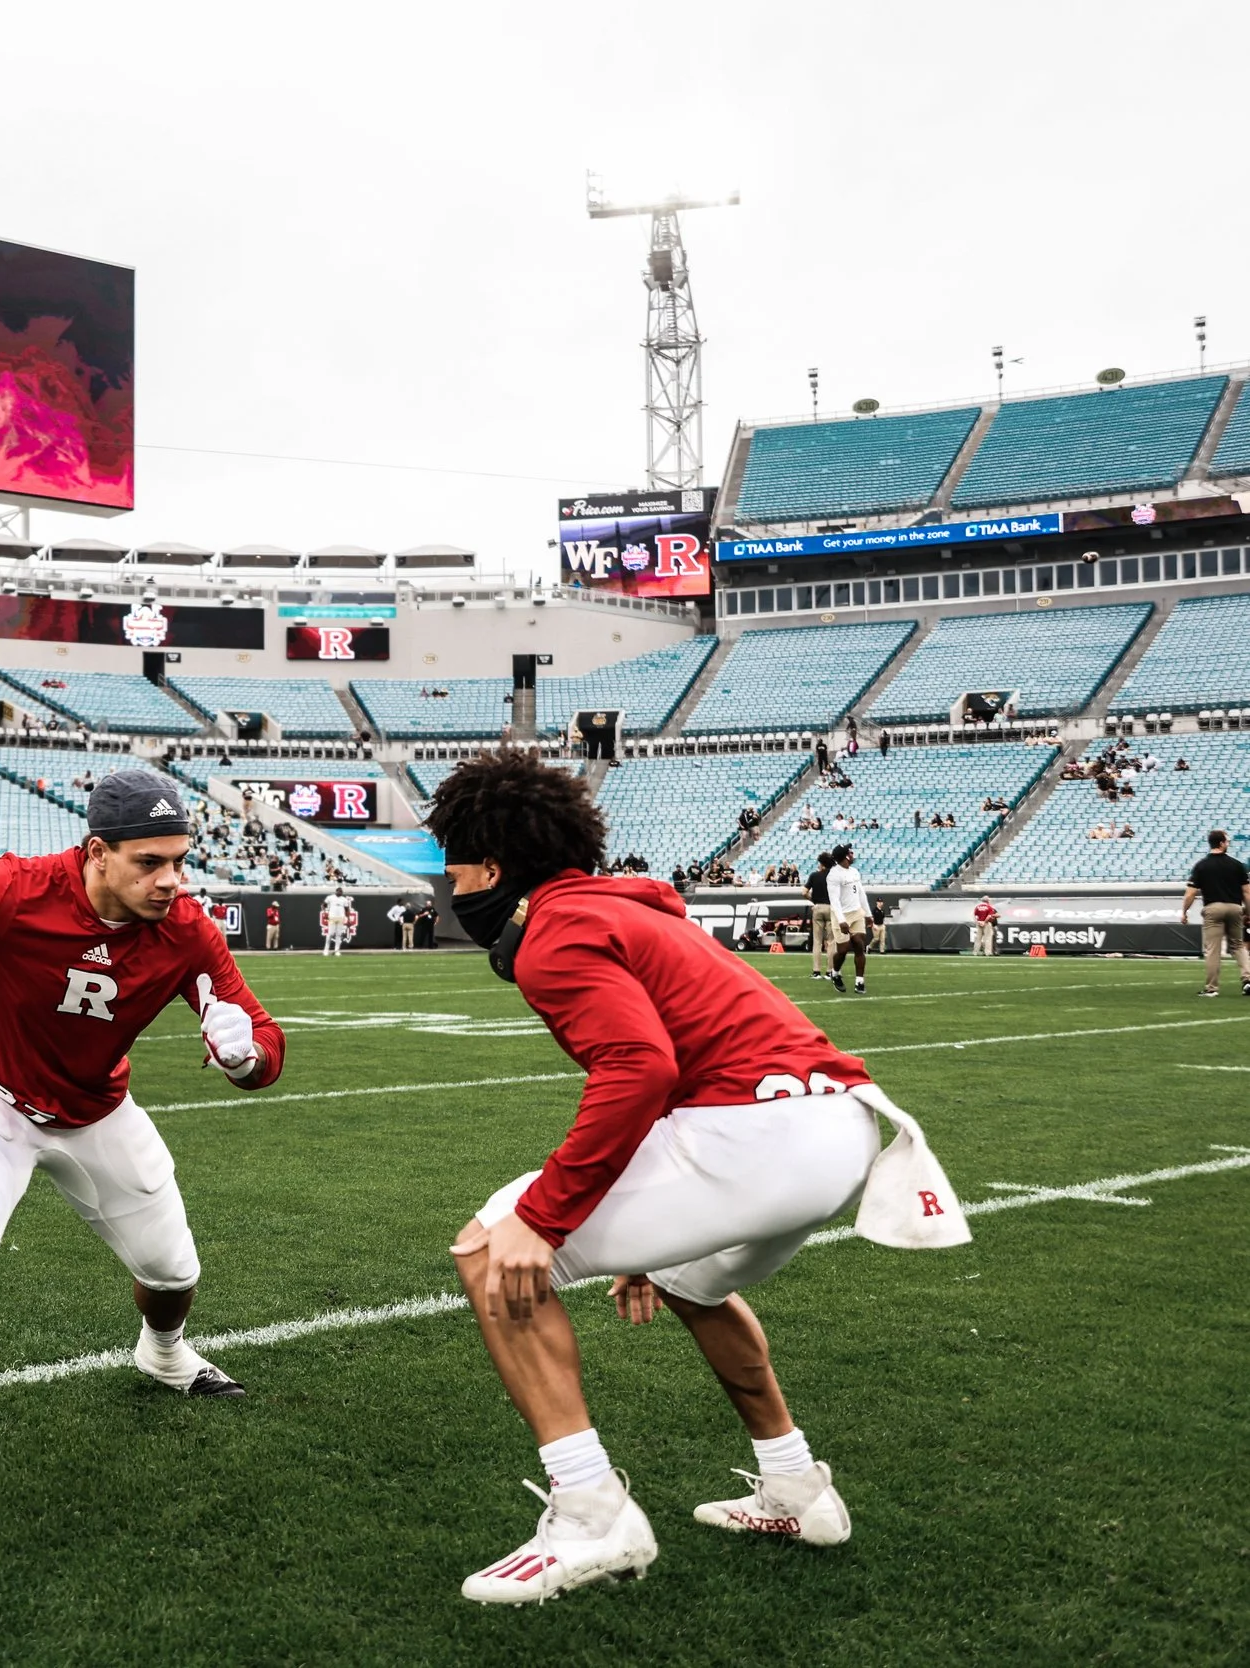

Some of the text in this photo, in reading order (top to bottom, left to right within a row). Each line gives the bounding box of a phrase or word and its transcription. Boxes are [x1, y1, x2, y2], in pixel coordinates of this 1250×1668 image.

[572, 500, 625, 517] Price.com
[979, 523, 1009, 535] TIAA
[1011, 518, 1041, 532] Bank
[746, 540, 804, 555] TIAA Bank
[823, 530, 951, 548] Get your money in the zone
[563, 540, 618, 579] WF
[654, 534, 704, 577] R
[318, 628, 354, 659] R
[332, 784, 370, 818] R
[150, 808, 178, 817] adidas
[1007, 926, 1107, 948] Fearlessly
[82, 952, 113, 966] adidas
[56, 968, 119, 1022] R
[918, 1190, 944, 1217] R
